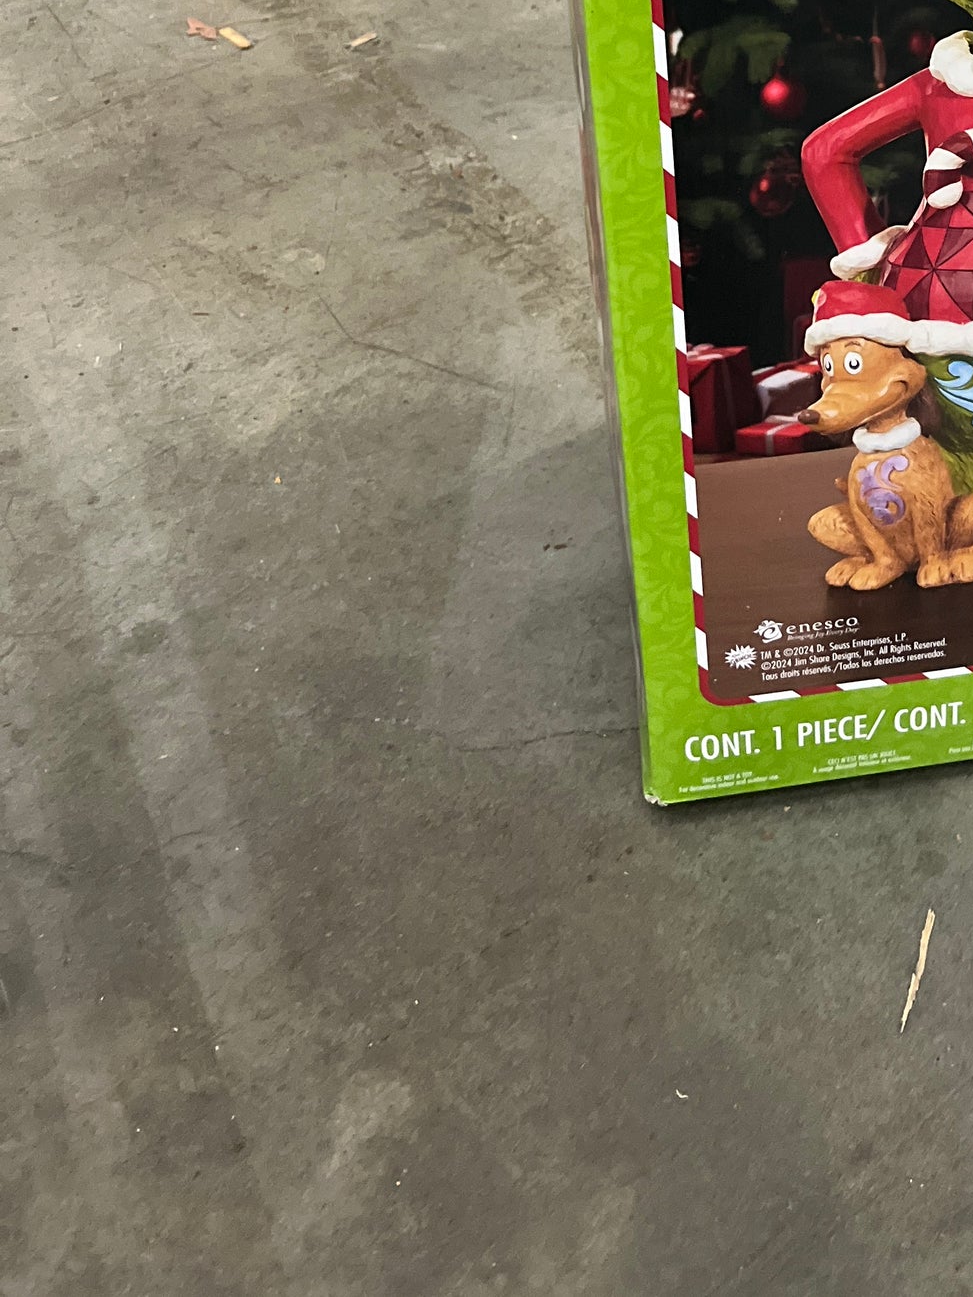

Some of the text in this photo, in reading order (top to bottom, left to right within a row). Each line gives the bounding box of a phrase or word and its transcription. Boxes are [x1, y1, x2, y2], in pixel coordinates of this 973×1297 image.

[785, 616, 859, 635] enesco
[760, 650, 772, 661] TM
[774, 649, 781, 659] &
[829, 641, 851, 651] Seuss
[852, 636, 893, 648] Enterprises,
[794, 658, 807, 667] Jim
[809, 655, 830, 665] Shore
[832, 651, 862, 662] Designs,
[863, 648, 877, 657] Inc.
[878, 645, 889, 655] All
[890, 643, 912, 654] Rights
[913, 637, 948, 650] Reserved.
[761, 672, 779, 681] Tous
[780, 669, 800, 679] droits
[861, 659, 872, 667] los
[873, 655, 905, 666] derechos
[906, 650, 947, 661] reservados.
[685, 729, 760, 763] CONT.
[772, 726, 783, 751] 1
[797, 709, 886, 748] PIECE/
[893, 702, 966, 734] CONT.
